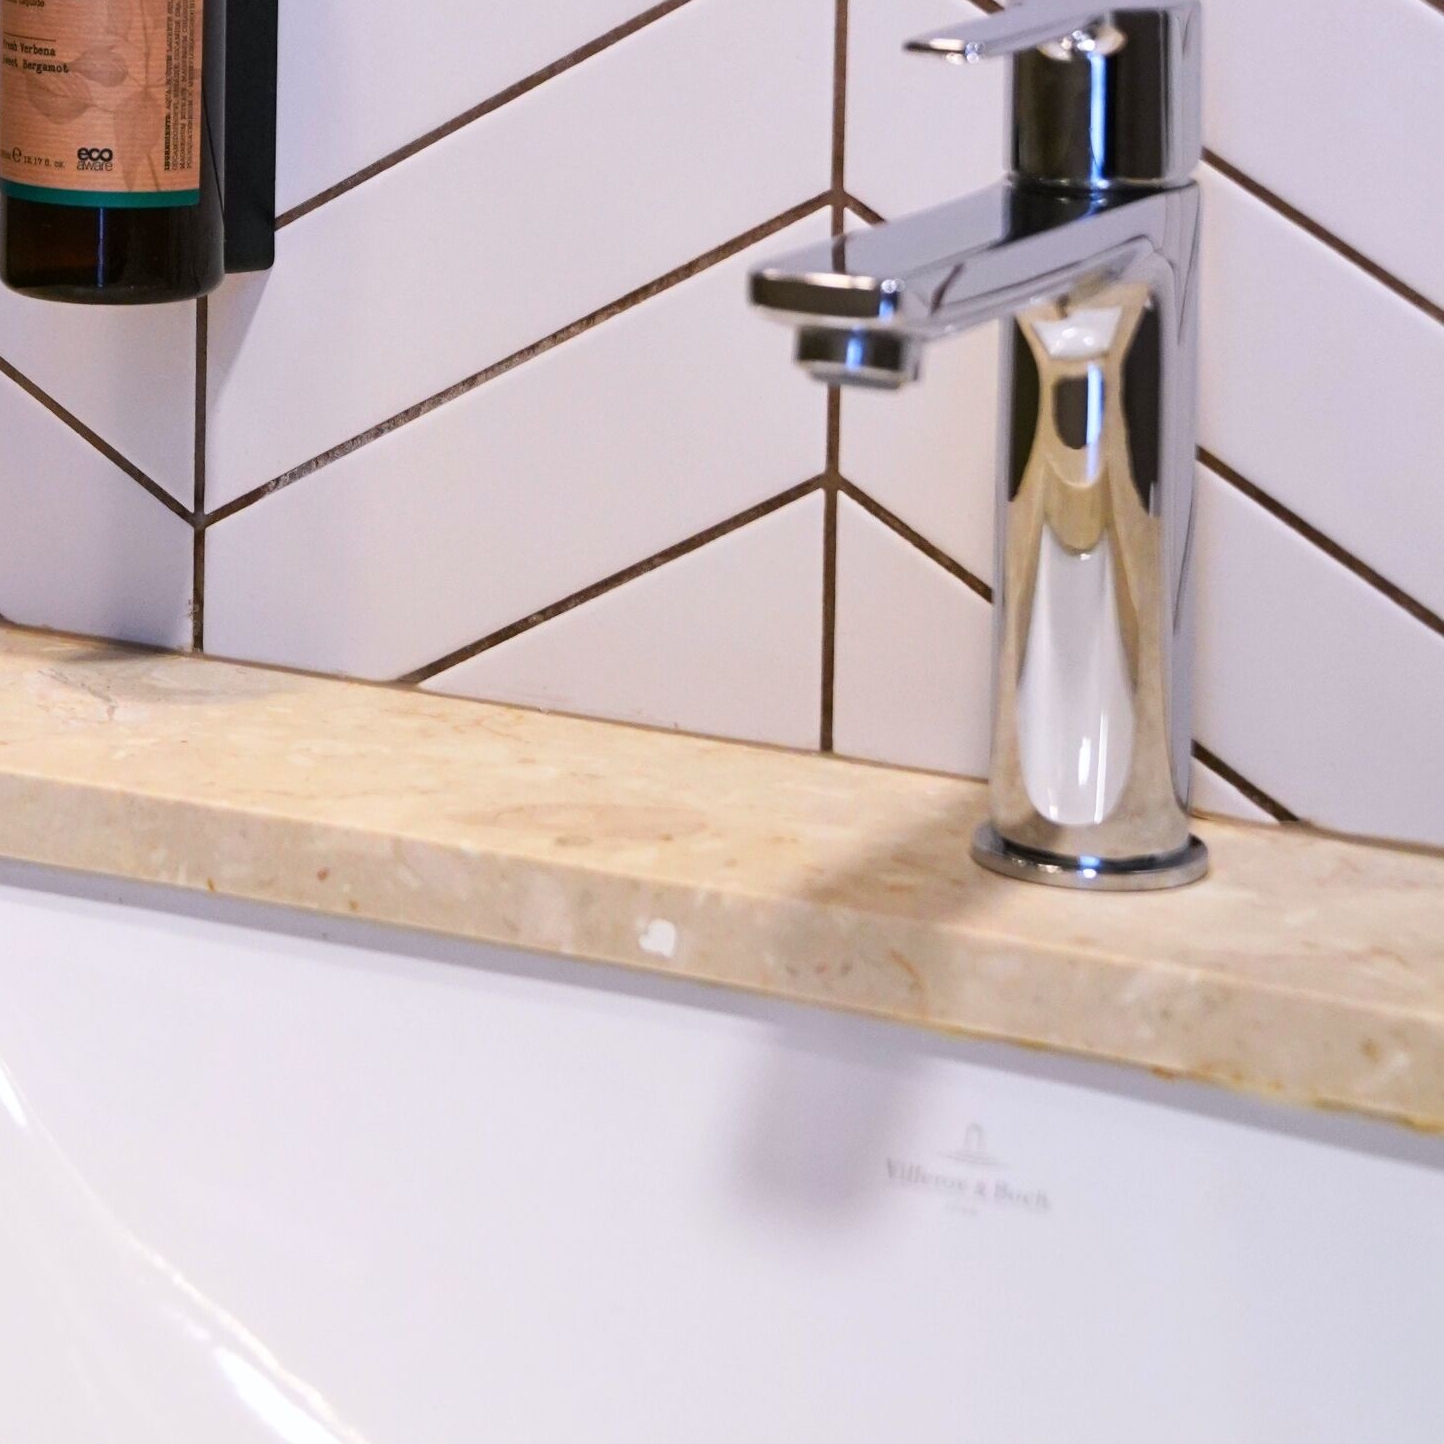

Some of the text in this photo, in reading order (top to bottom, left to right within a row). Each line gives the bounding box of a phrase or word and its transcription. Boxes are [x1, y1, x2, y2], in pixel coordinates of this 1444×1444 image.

[20, 42, 56, 56] Verbena
[23, 58, 69, 74] Bergamot
[77, 147, 113, 161] eco
[76, 159, 113, 172] aware
